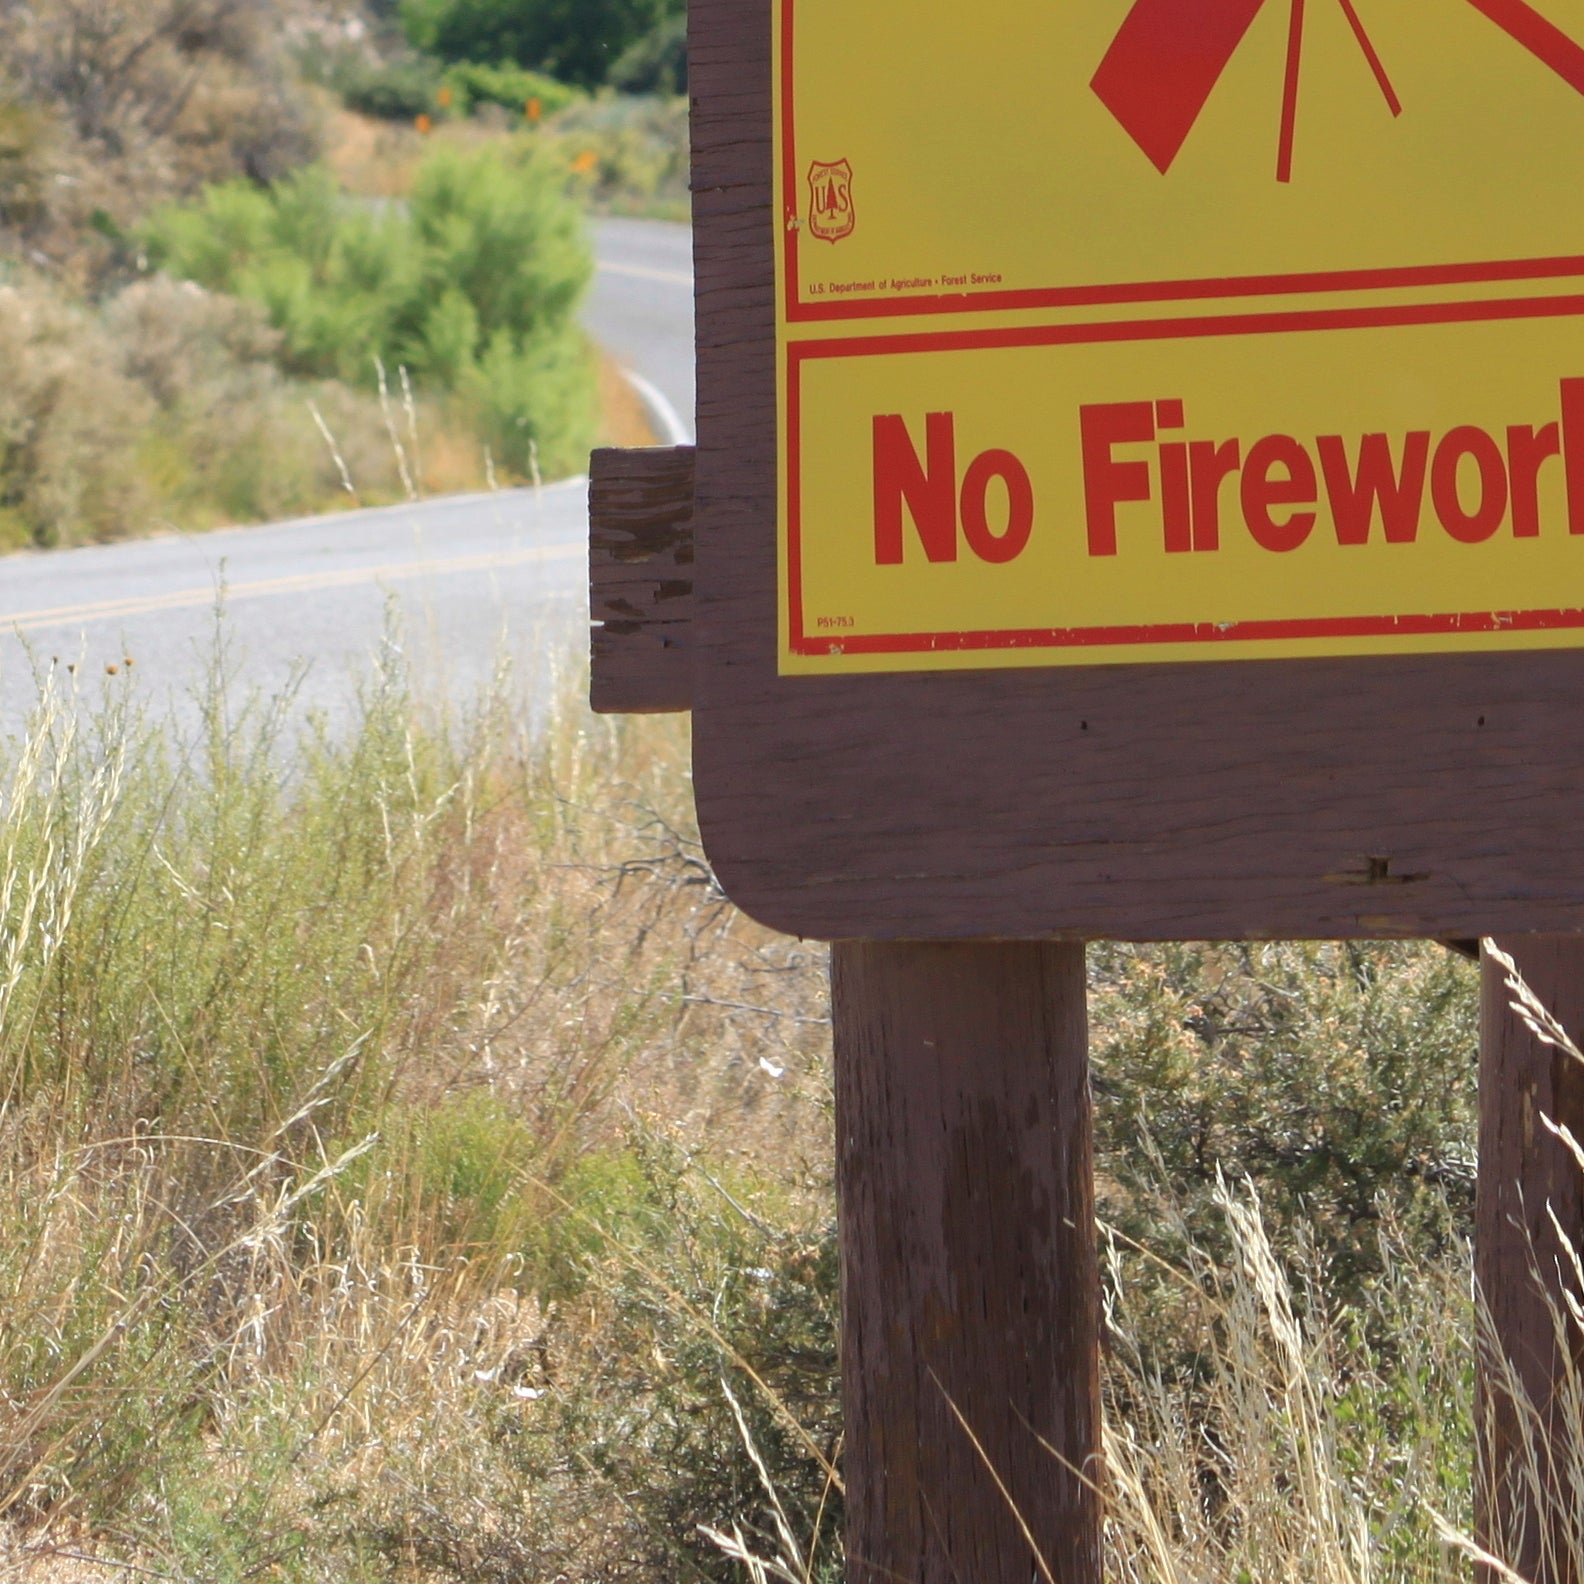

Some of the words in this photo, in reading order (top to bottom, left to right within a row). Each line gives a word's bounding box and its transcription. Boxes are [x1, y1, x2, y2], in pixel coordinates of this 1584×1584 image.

[809, 282, 824, 295] U.S.
[829, 282, 875, 294] Department
[878, 279, 887, 290] of
[891, 278, 933, 292] Agriculture
[941, 274, 967, 286] Forest
[970, 273, 1002, 285] Service
[872, 411, 1034, 565] No
